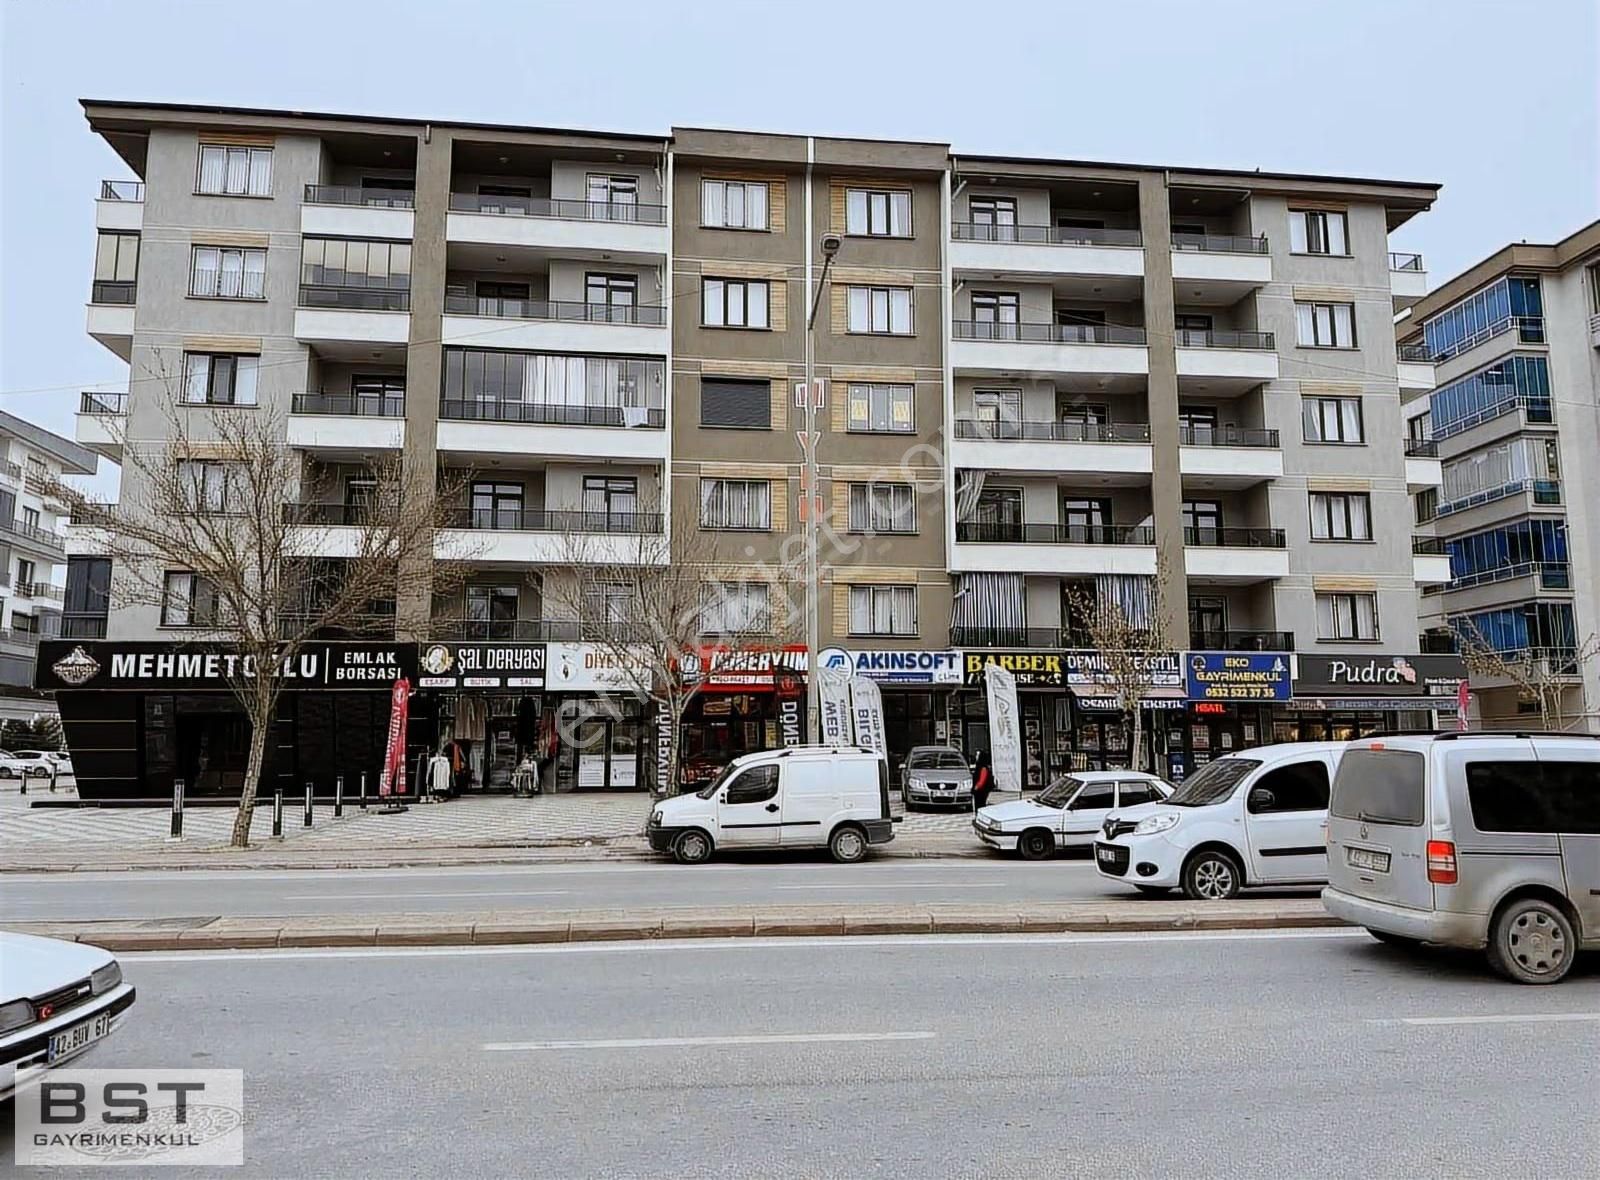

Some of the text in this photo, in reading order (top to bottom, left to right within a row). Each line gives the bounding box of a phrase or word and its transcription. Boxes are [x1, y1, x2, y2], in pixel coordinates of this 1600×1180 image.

[343, 652, 397, 664] EMLAK
[856, 653, 957, 669] AKINSOFT
[967, 654, 1062, 673] BARBER
[1224, 657, 1249, 668] EKO
[336, 667, 401, 680] BORSASI
[1196, 669, 1283, 682] GAYRİMENKUL
[1329, 660, 1400, 683] Pudra
[1205, 688, 1229, 698] 0532
